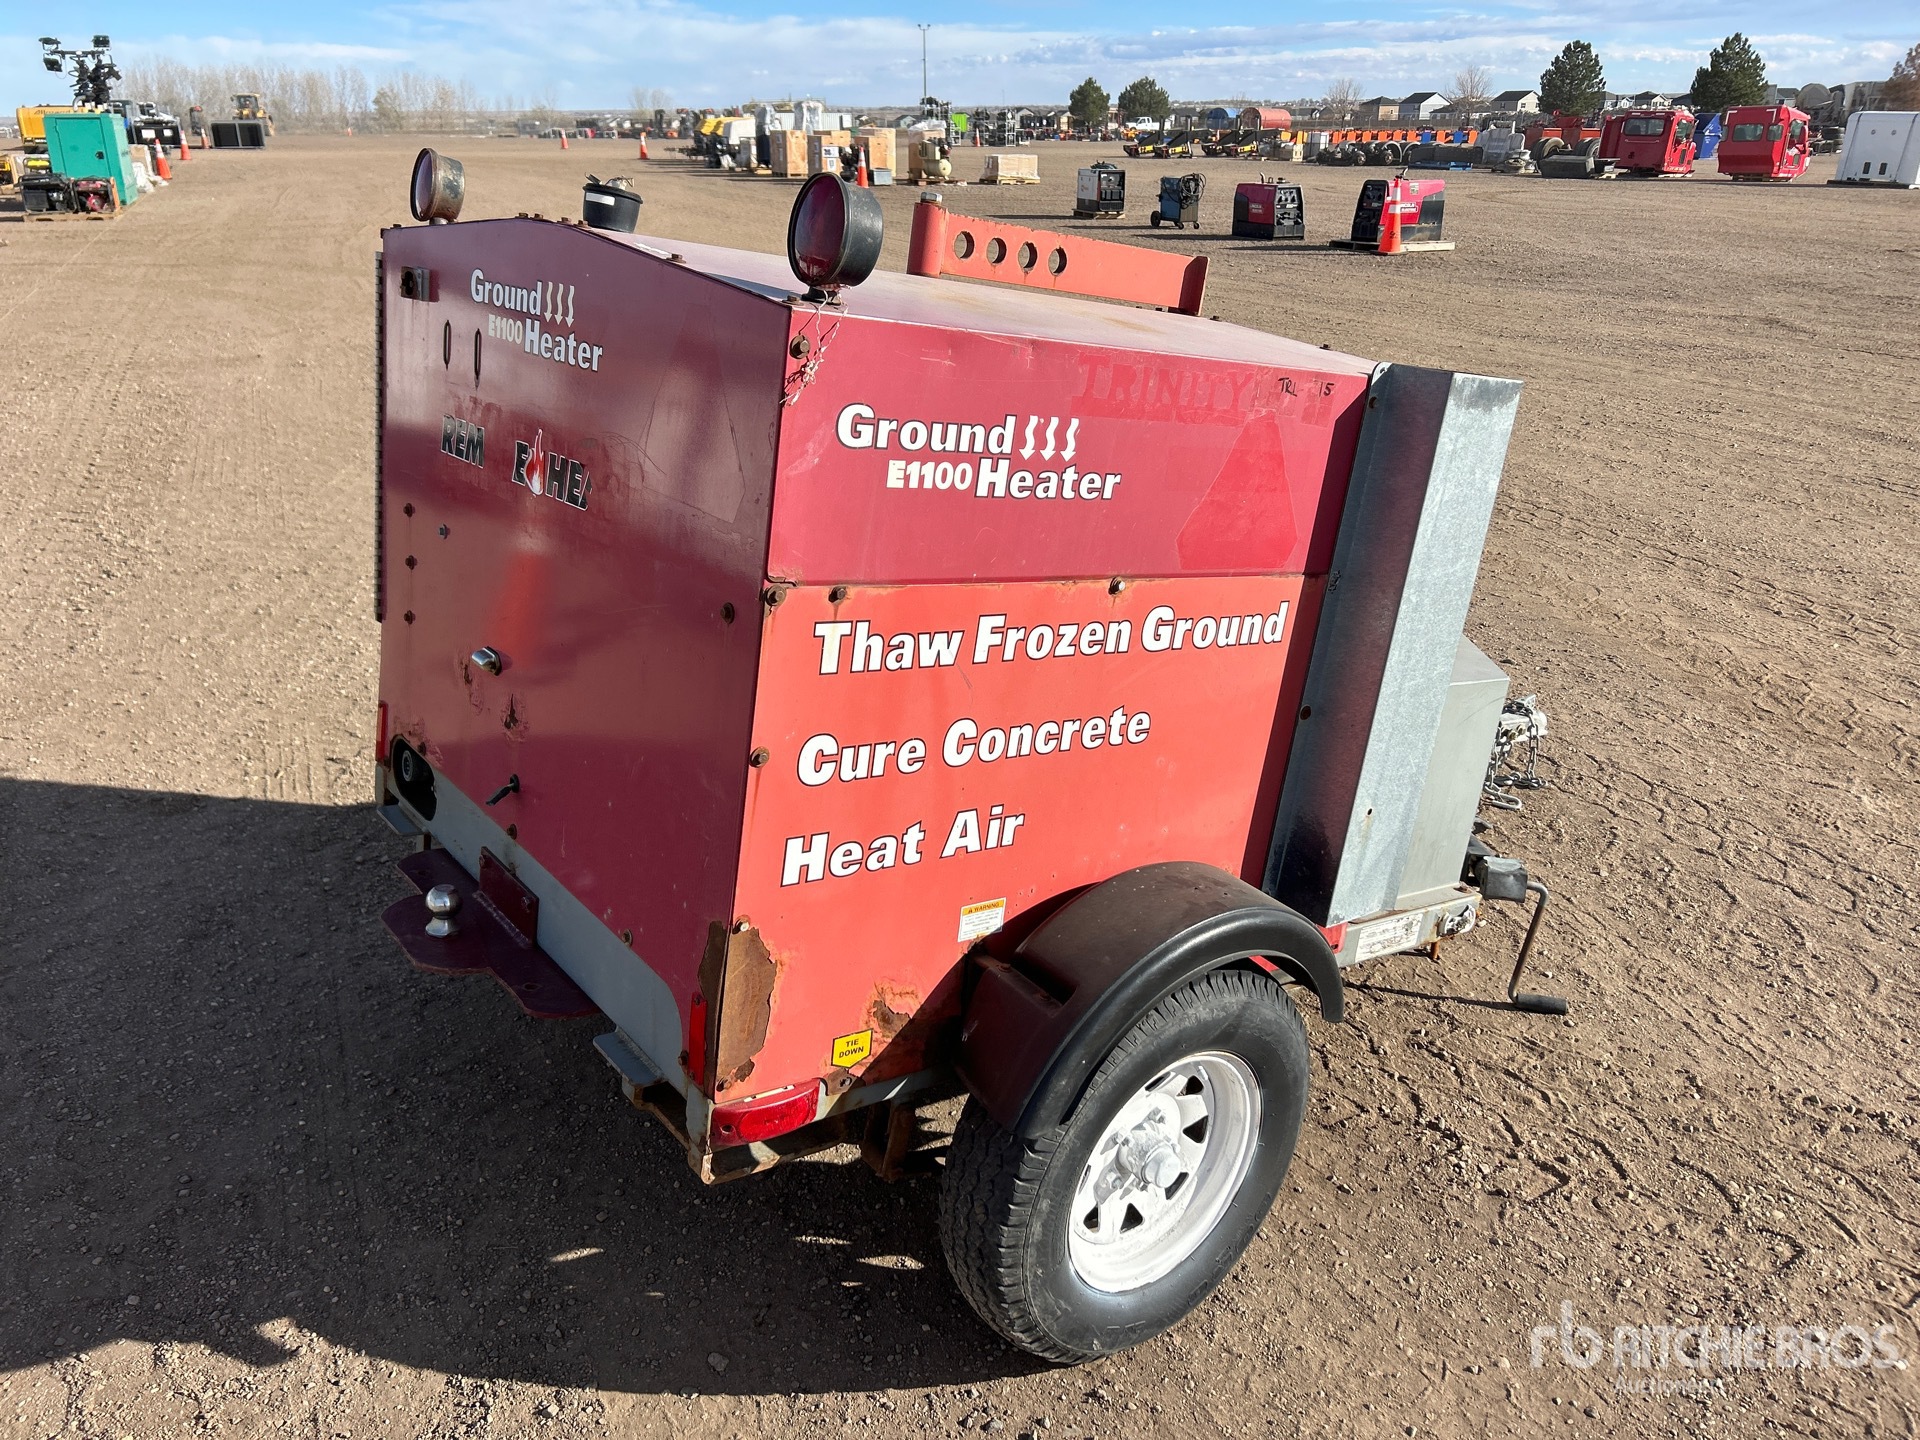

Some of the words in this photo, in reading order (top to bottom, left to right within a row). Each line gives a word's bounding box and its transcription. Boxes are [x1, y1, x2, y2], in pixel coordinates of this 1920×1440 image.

[470, 268, 543, 316] Ground
[487, 313, 523, 345] E1100
[523, 319, 603, 372] Heater
[836, 403, 1018, 456] Ground
[886, 458, 974, 491] E1100
[974, 459, 1122, 501] Heater
[814, 620, 965, 675] Thaw
[972, 613, 1132, 665] Frozen
[1140, 600, 1290, 653] Ground
[797, 732, 927, 787] Cure
[942, 705, 1152, 767] Concrete
[780, 821, 926, 887] Heat
[940, 804, 1026, 859] Air
[974, 901, 1000, 912] WARNING
[838, 1046, 864, 1058] DOWN
[845, 1039, 859, 1048] TIE
